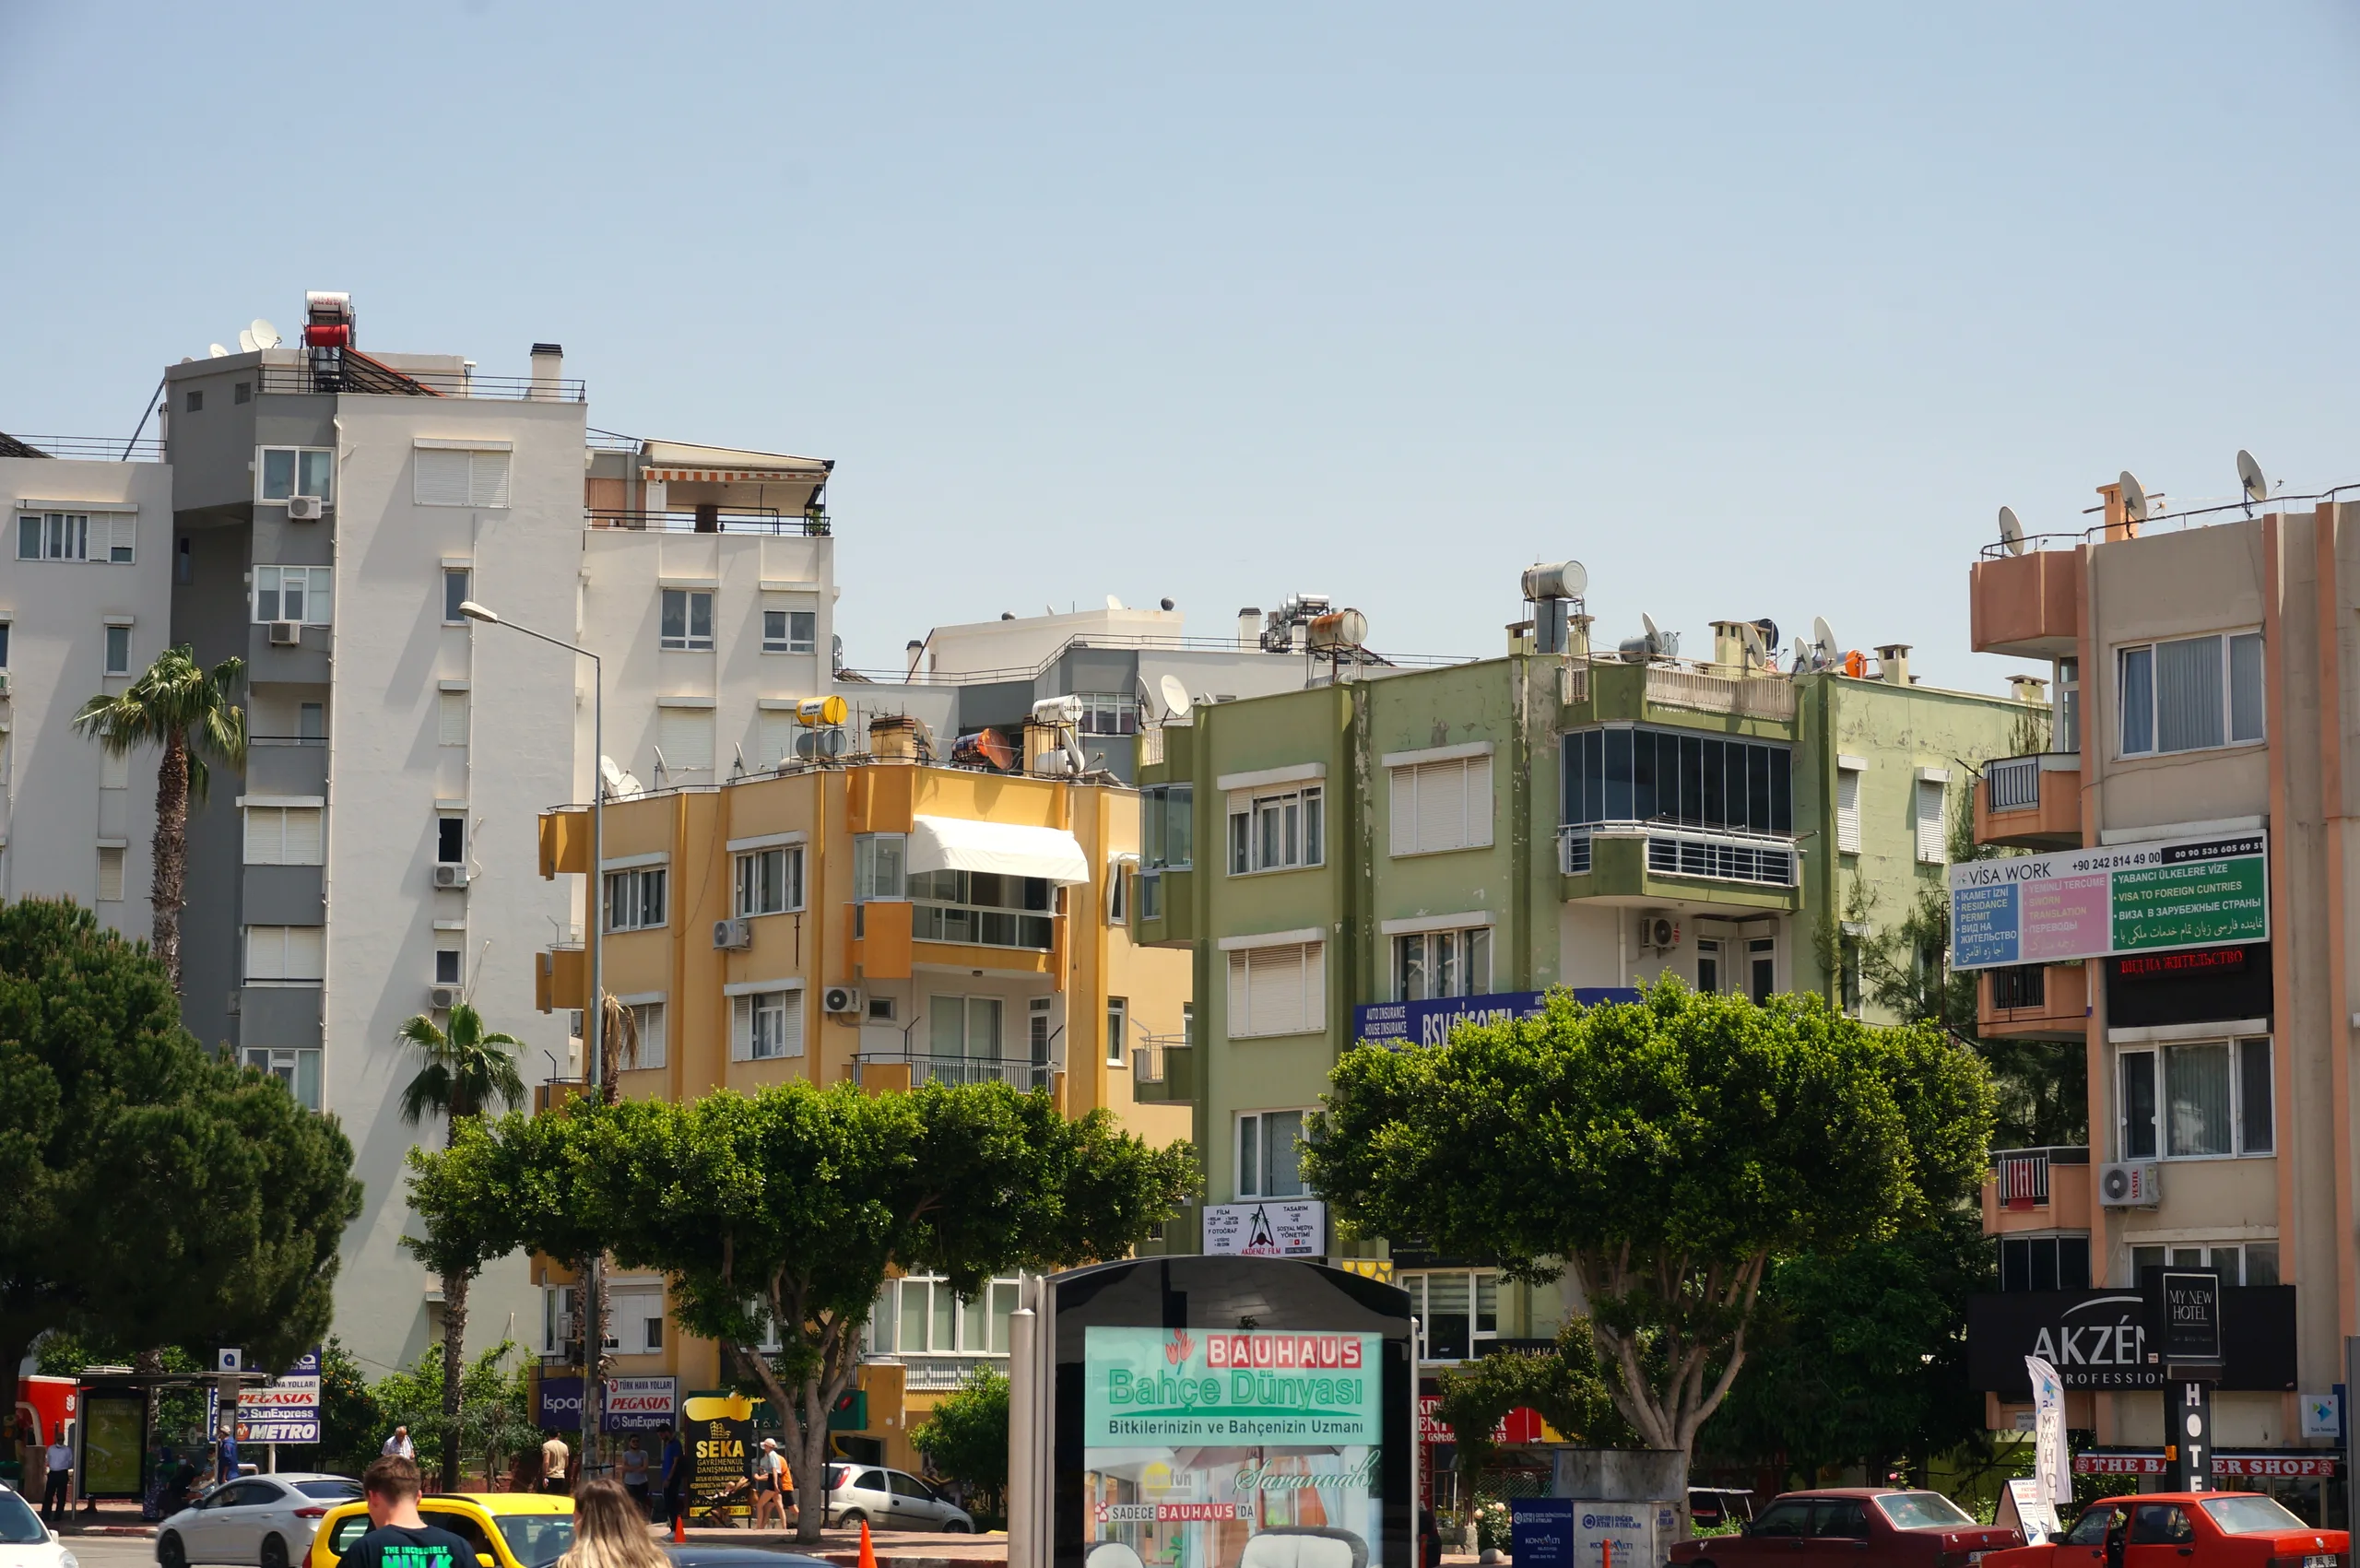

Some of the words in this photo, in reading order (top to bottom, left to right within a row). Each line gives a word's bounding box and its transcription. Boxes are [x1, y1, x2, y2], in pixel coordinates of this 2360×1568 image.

[2175, 851, 2186, 859] 00
[2188, 848, 2200, 857] 90
[2201, 846, 2219, 855] 536
[2220, 844, 2237, 854] 605
[2239, 843, 2251, 852] 69
[2253, 842, 2263, 850] 51
[2072, 858, 2090, 871] +90
[2093, 856, 2110, 870] 242
[2113, 854, 2130, 867] 814
[2133, 853, 2146, 865] 49
[2148, 852, 2161, 864] 00
[1968, 866, 2001, 886] VİSA
[2005, 862, 2051, 881] WORK
[2118, 872, 2157, 885] YABANCI
[2158, 866, 2206, 880] ÜLKELERE
[2209, 863, 2228, 874] VİZE
[2028, 880, 2062, 894] YEMİNLİ
[2064, 877, 2106, 890] TERCÜME
[2118, 890, 2139, 902] VISA
[2142, 890, 2153, 900] TO
[2154, 884, 2195, 899] FOREIGN
[2197, 881, 2242, 894] CUNTRIES
[1961, 890, 1991, 902] İKAMET
[1992, 887, 2009, 898] İZNİ
[2029, 895, 2060, 907] SWORN
[1961, 899, 2008, 912] RESIDANCE
[2118, 909, 2143, 921] ВИЗА
[2147, 906, 2154, 917] В
[2155, 901, 2220, 917] ЗАРУБЕЖНЫЕ
[2222, 897, 2261, 911] СТРАНЫ
[1961, 911, 1991, 923] PERMIT
[2028, 906, 2087, 920] TRANSLATION
[1961, 924, 1979, 935] ВИД
[1980, 922, 1992, 931] НА
[2029, 922, 2078, 934] ПЕРЕВОДЫ
[1960, 930, 2017, 944] ЖИТЕЛЬСТВО
[1366, 1008, 1378, 1020] AUTO
[1379, 1006, 1406, 1019] INSURANCE
[1365, 1022, 1380, 1035] HOUSE
[1381, 1020, 1407, 1034] INSURANCE
[1422, 1013, 1450, 1050] BSV
[1241, 1246, 1266, 1255] AKDENİZ
[2169, 1290, 2186, 1304] MY
[2189, 1290, 2212, 1304] NEW
[2173, 1305, 2208, 1320] HOTEL
[1209, 1338, 1360, 1364] BAUHAUS
[620, 1380, 633, 1390] TÜRK
[634, 1381, 648, 1390] HAVA
[650, 1380, 672, 1389] YOLLARI
[1109, 1369, 1221, 1412] Bahçe
[1231, 1369, 1363, 1411] Dünyası
[238, 1393, 315, 1404] PEGASUS
[610, 1397, 671, 1410] PEGASUS
[251, 1409, 313, 1419] SunExpress
[621, 1416, 670, 1429] SunExpress
[1109, 1421, 1202, 1434] Bitkilerinizin
[1208, 1422, 1224, 1433] ve
[1229, 1421, 1306, 1437] Bahçenizin
[1311, 1421, 1363, 1434] Uzmanı
[249, 1424, 316, 1440] METRO
[2186, 1384, 2202, 1492] HOTE
[696, 1440, 745, 1458] SEKA
[697, 1458, 744, 1467] GAYRİMENKUL
[2092, 1458, 2139, 1473] THE
[2144, 1459, 2243, 1473] BAER
[2249, 1460, 2316, 1474] SHOP
[697, 1466, 744, 1474] DANIŞMANLIK
[1233, 1449, 1381, 1494] Savannah
[1113, 1506, 1154, 1519] SADECE
[1159, 1505, 1233, 1519] BAUHAUS
[384, 1546, 399, 1554] THE
[401, 1546, 448, 1555] INCREDIBLE
